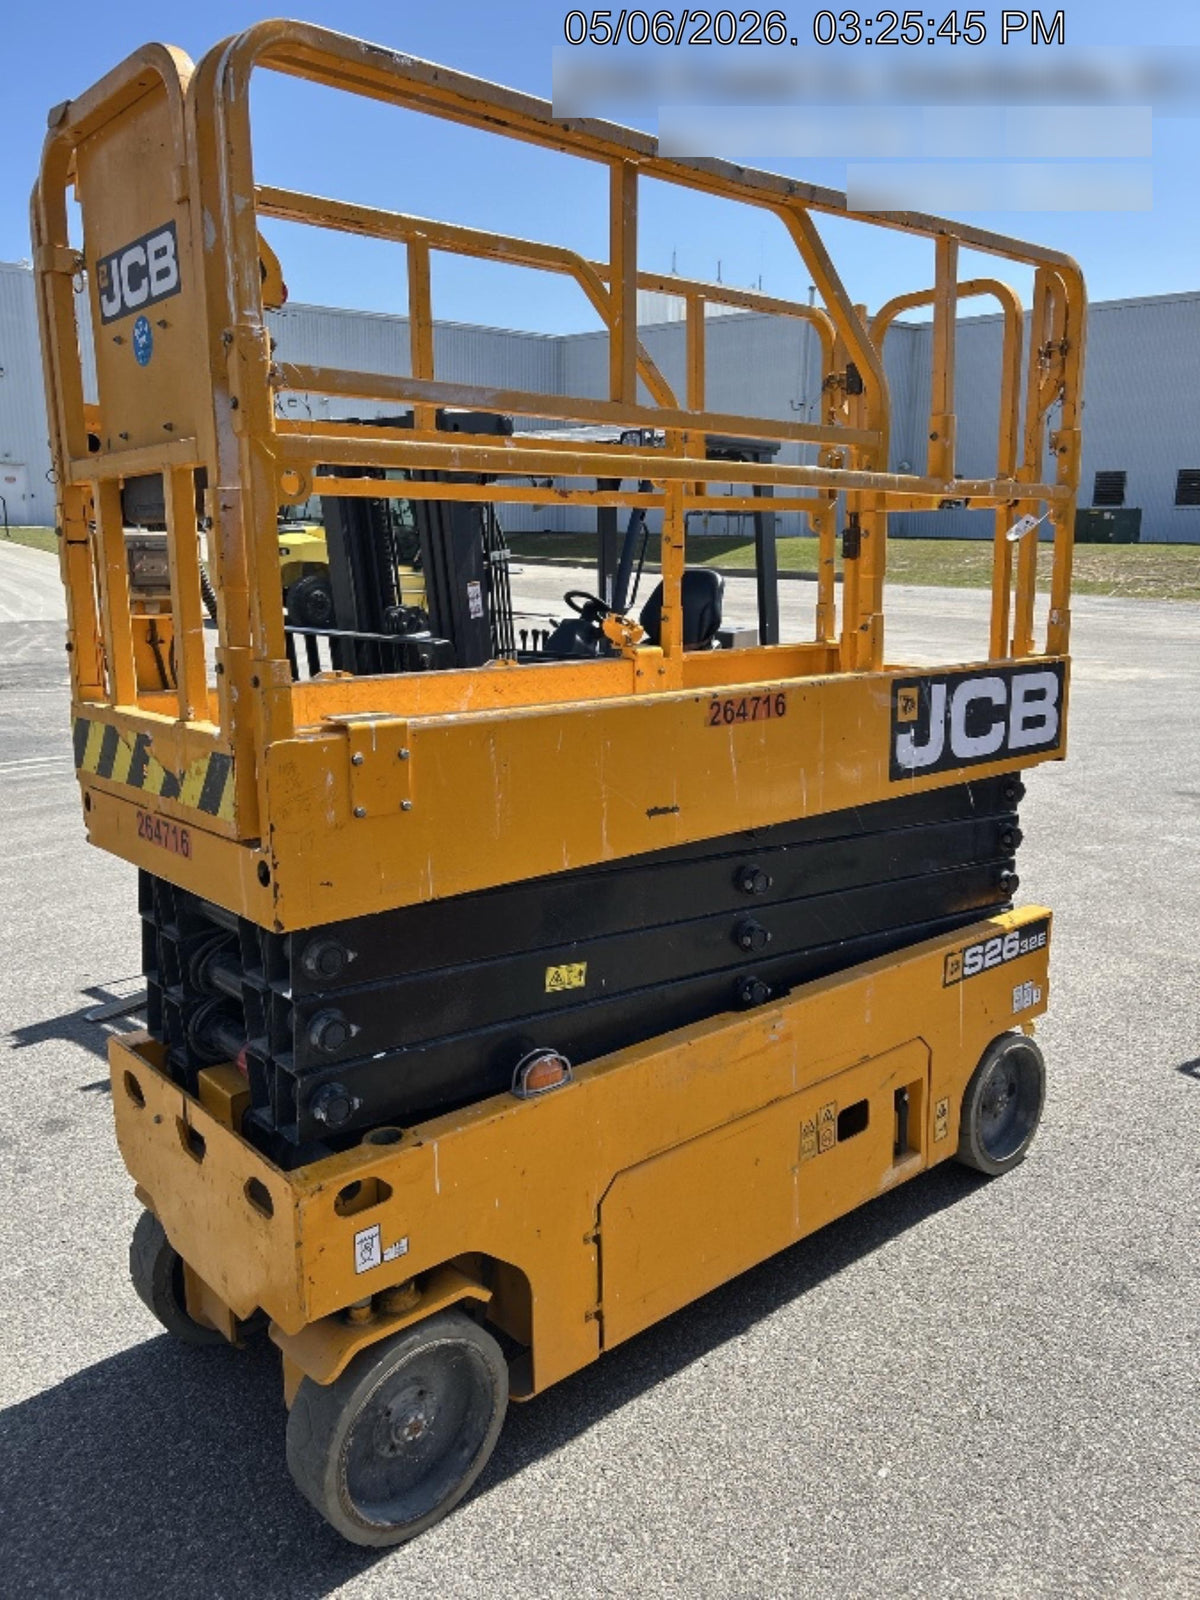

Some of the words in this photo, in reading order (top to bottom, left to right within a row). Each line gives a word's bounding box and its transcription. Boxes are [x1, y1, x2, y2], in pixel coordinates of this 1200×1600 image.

[101, 230, 178, 317] JCB
[708, 692, 786, 726] 264716
[895, 671, 1059, 768] JCB
[136, 809, 190, 858] 264716
